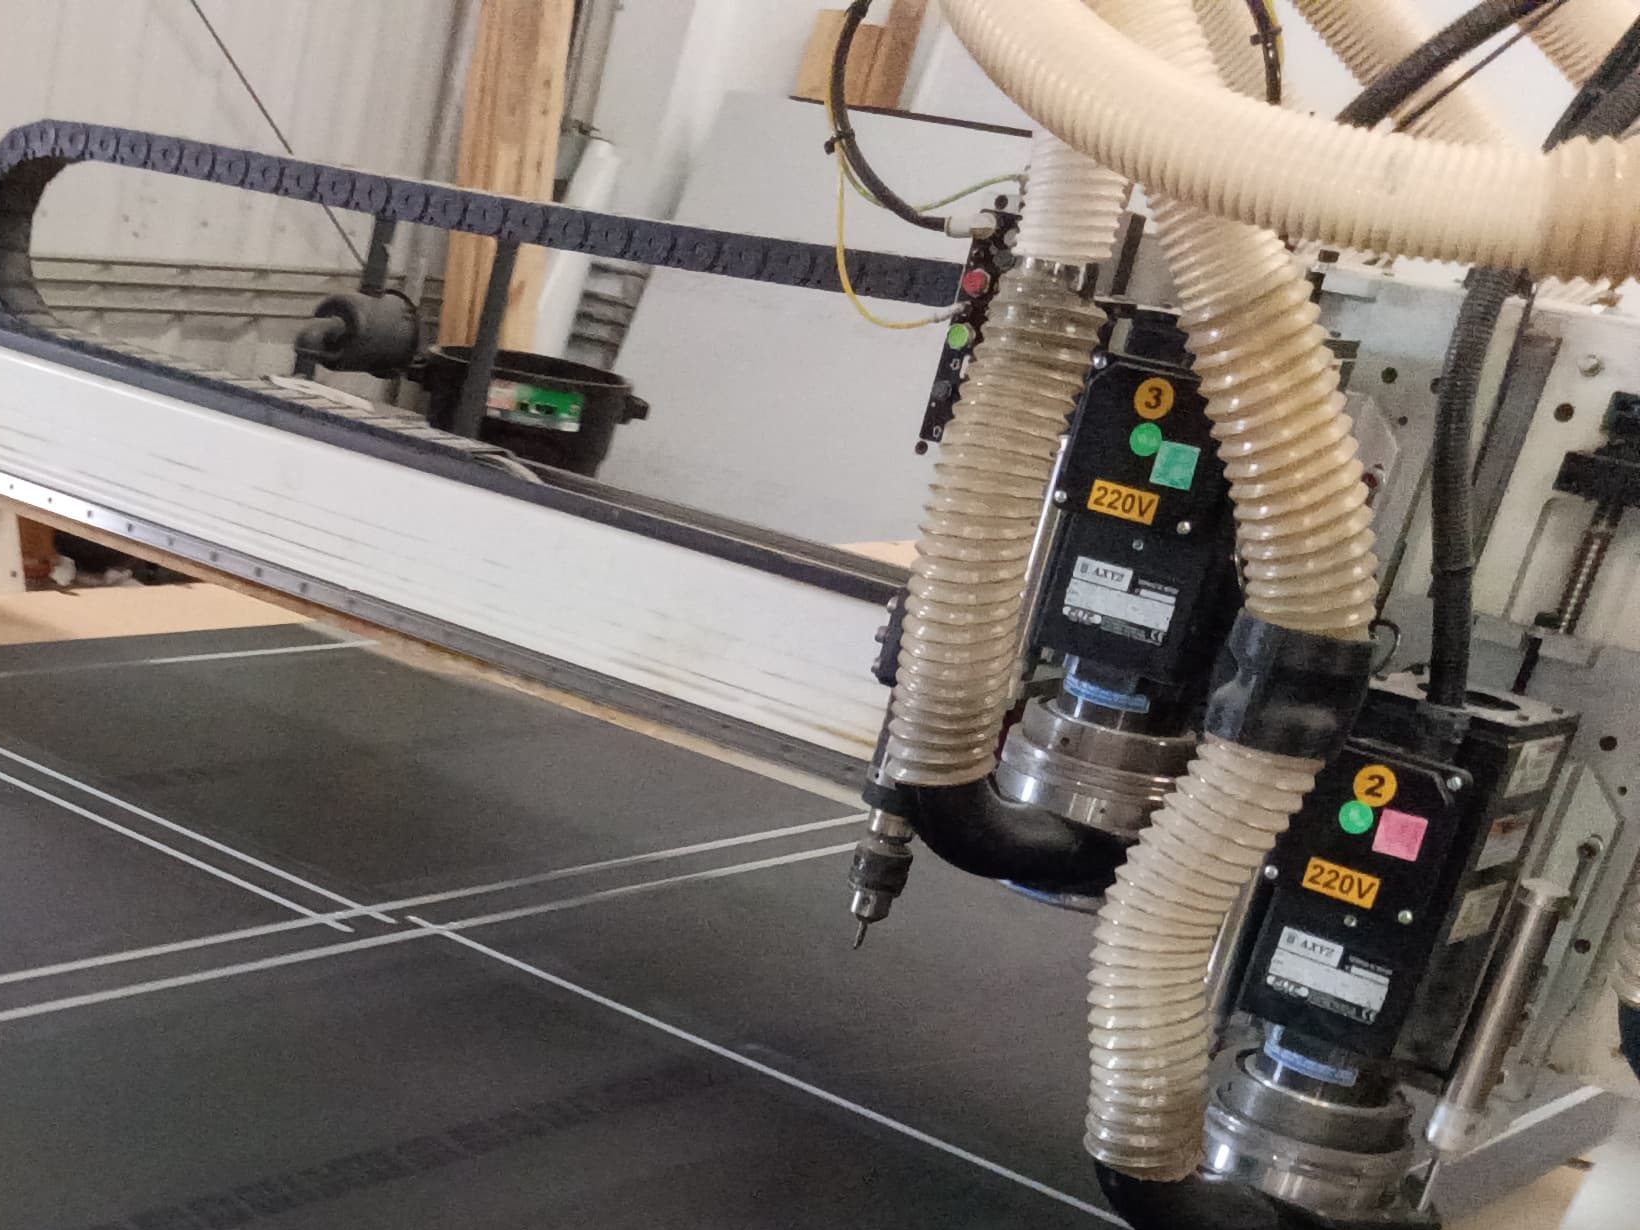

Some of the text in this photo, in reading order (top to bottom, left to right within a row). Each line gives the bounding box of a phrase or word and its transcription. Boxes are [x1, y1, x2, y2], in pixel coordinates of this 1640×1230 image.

[1145, 387, 1162, 410] 3
[1093, 486, 1155, 518] 220V
[1365, 775, 1385, 798] 2
[1308, 865, 1377, 899] 220V
